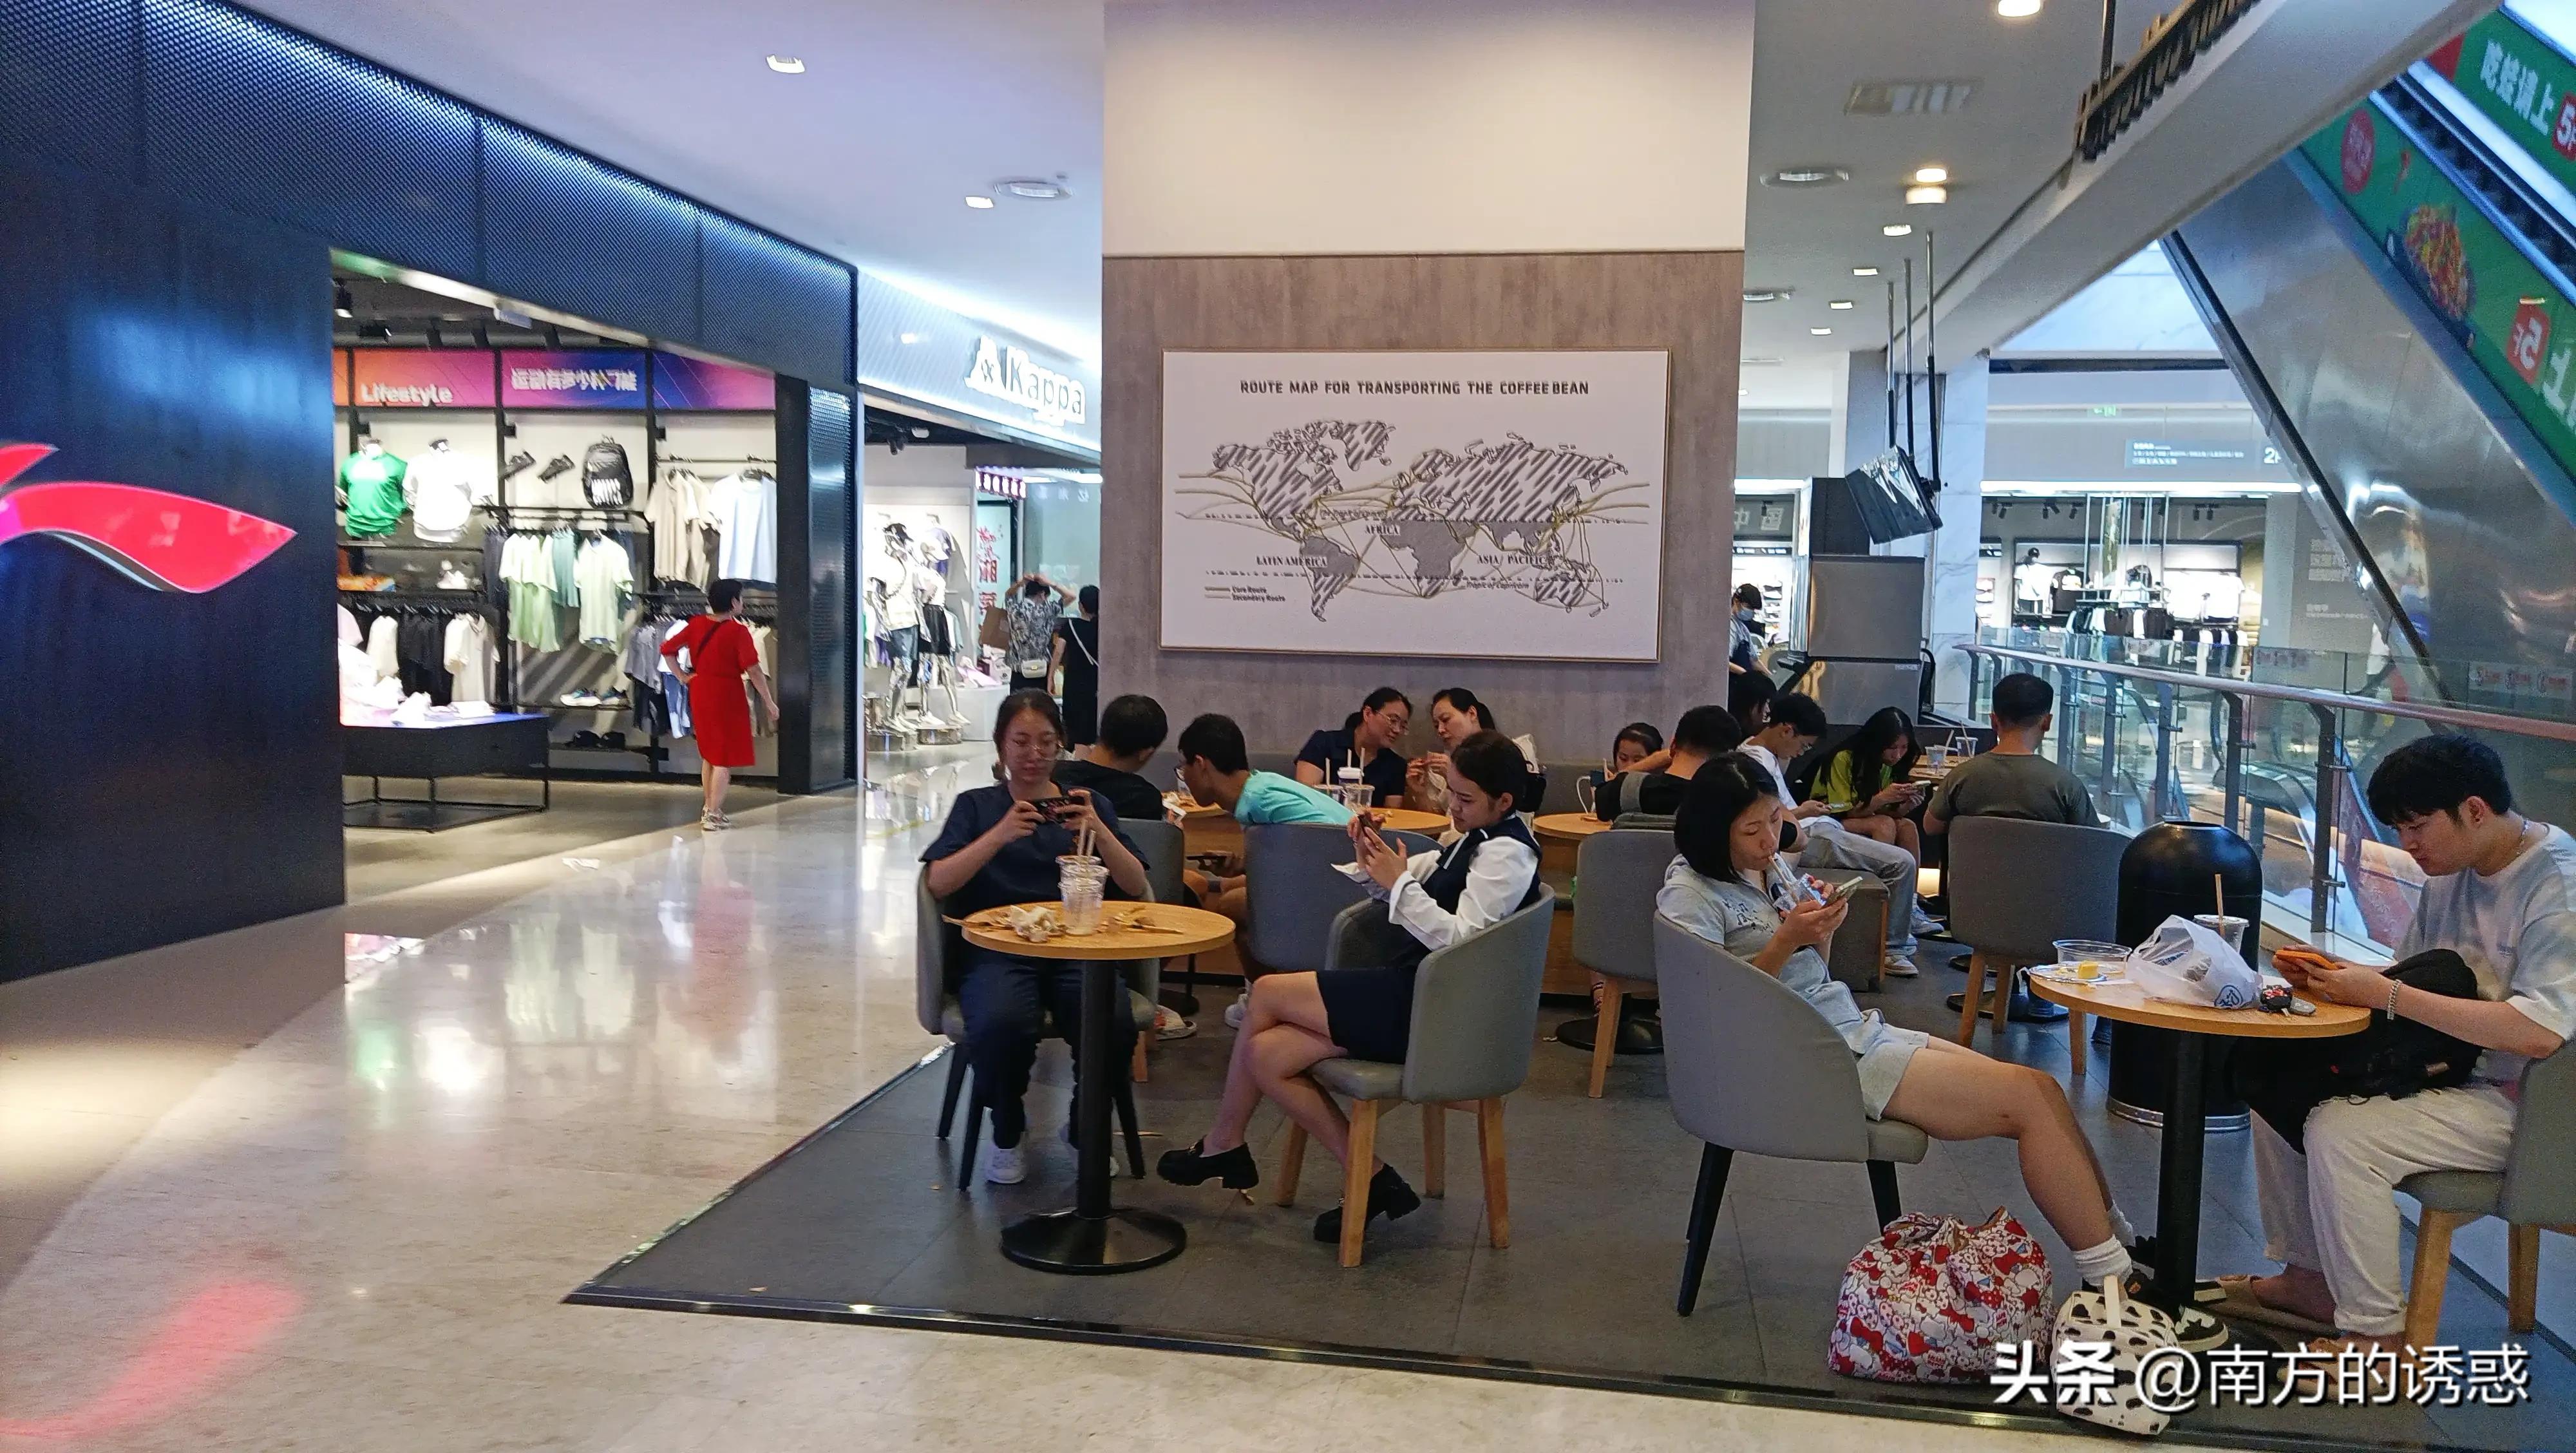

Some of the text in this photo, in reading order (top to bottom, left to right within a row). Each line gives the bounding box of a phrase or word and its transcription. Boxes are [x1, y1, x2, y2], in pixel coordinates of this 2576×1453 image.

[1007, 348, 1086, 425] Kappa
[1240, 380, 1589, 395] ROUTE MAP FOR TRANSPORTING THE COFFEE BEAN
[361, 382, 453, 406] Lifestyle
[1365, 524, 1400, 535] AFRICA
[1256, 556, 1327, 567] LATIN AMERICA
[1507, 554, 1546, 565] PACIFIC
